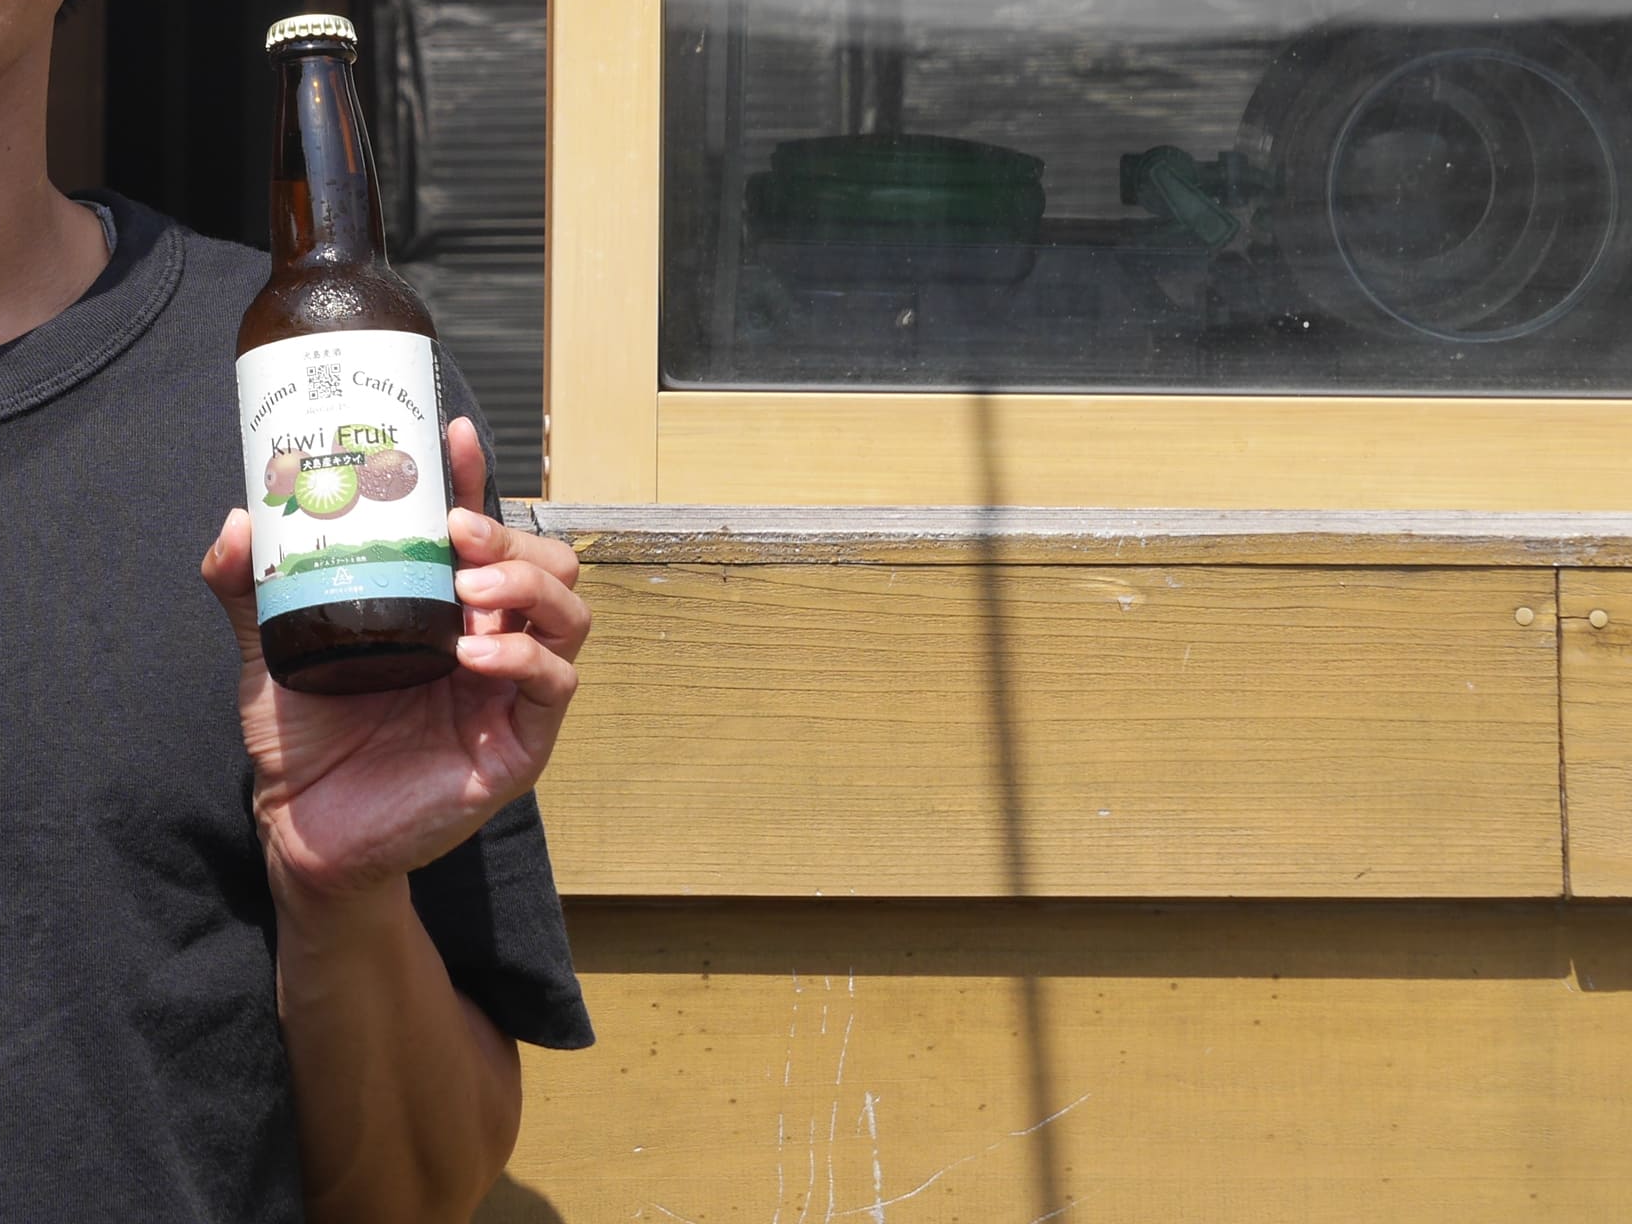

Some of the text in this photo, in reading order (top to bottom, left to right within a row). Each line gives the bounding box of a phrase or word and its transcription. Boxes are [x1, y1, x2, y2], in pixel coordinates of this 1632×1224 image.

[250, 370, 425, 433] Inujima Craft Beer
[271, 423, 399, 458] Kiwi Fruit
